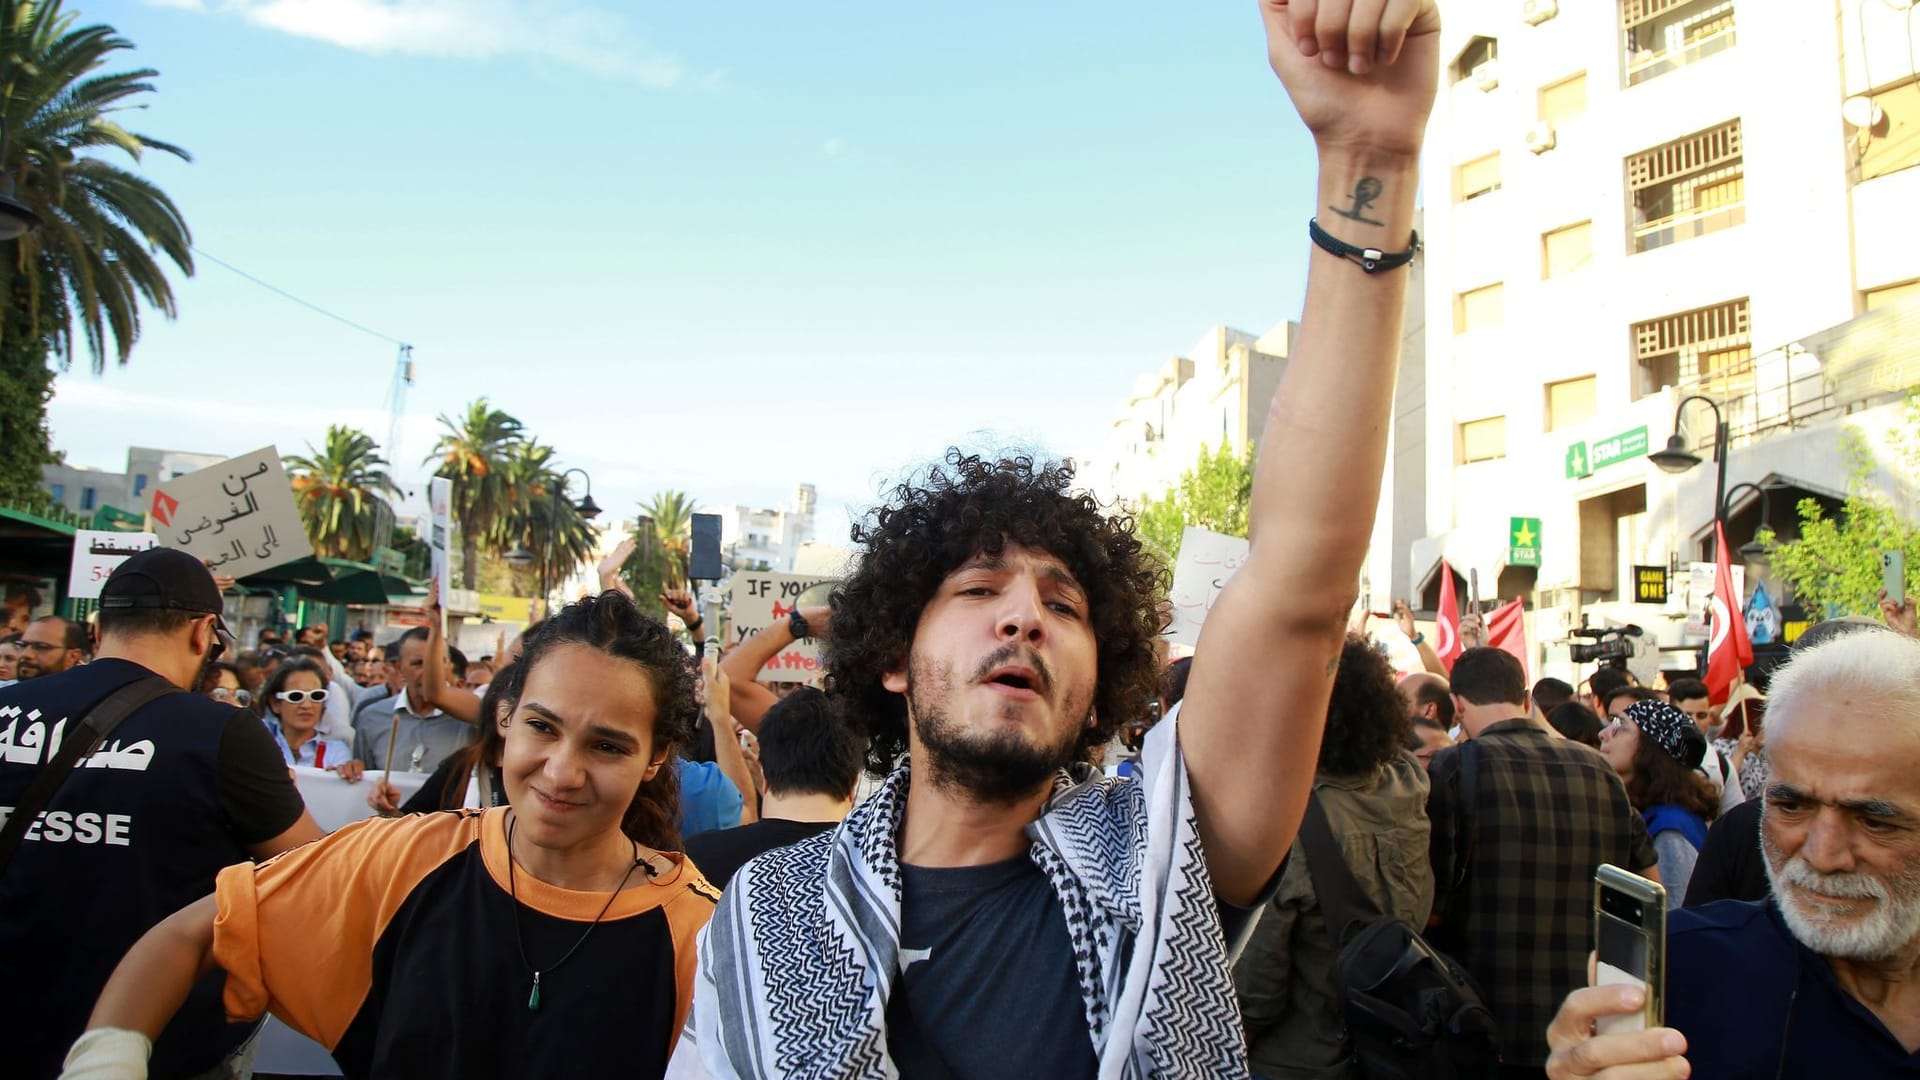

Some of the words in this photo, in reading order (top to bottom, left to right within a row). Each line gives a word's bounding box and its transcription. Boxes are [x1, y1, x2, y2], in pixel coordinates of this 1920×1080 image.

[1593, 439, 1621, 464] STAR
[222, 462, 268, 496] من
[176, 490, 259, 545] الفوضى
[206, 539, 247, 571] العب
[254, 524, 280, 559] إلى
[1513, 550, 1535, 561] STAR
[747, 579, 771, 598] IF
[1640, 570, 1664, 582] GAME
[1640, 584, 1664, 598] ONE
[0, 806, 131, 846] ESSE
